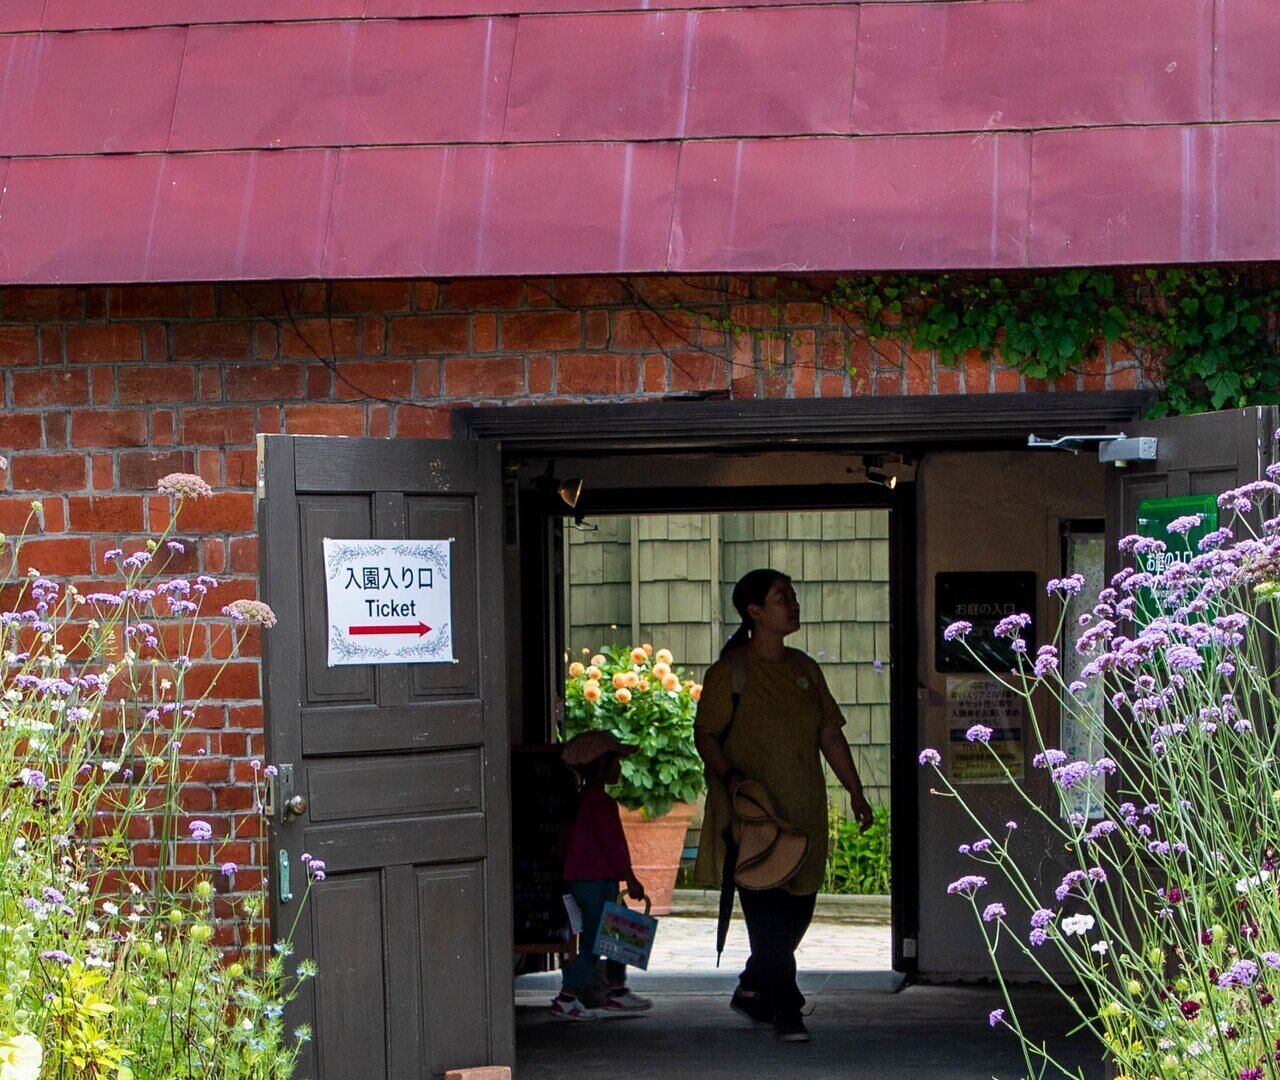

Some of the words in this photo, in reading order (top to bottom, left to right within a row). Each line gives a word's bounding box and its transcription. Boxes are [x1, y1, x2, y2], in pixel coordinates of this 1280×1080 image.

[345, 567, 433, 590] 入園入り口
[365, 600, 416, 617] Ticket
[955, 602, 1015, 616] お庭の入口
